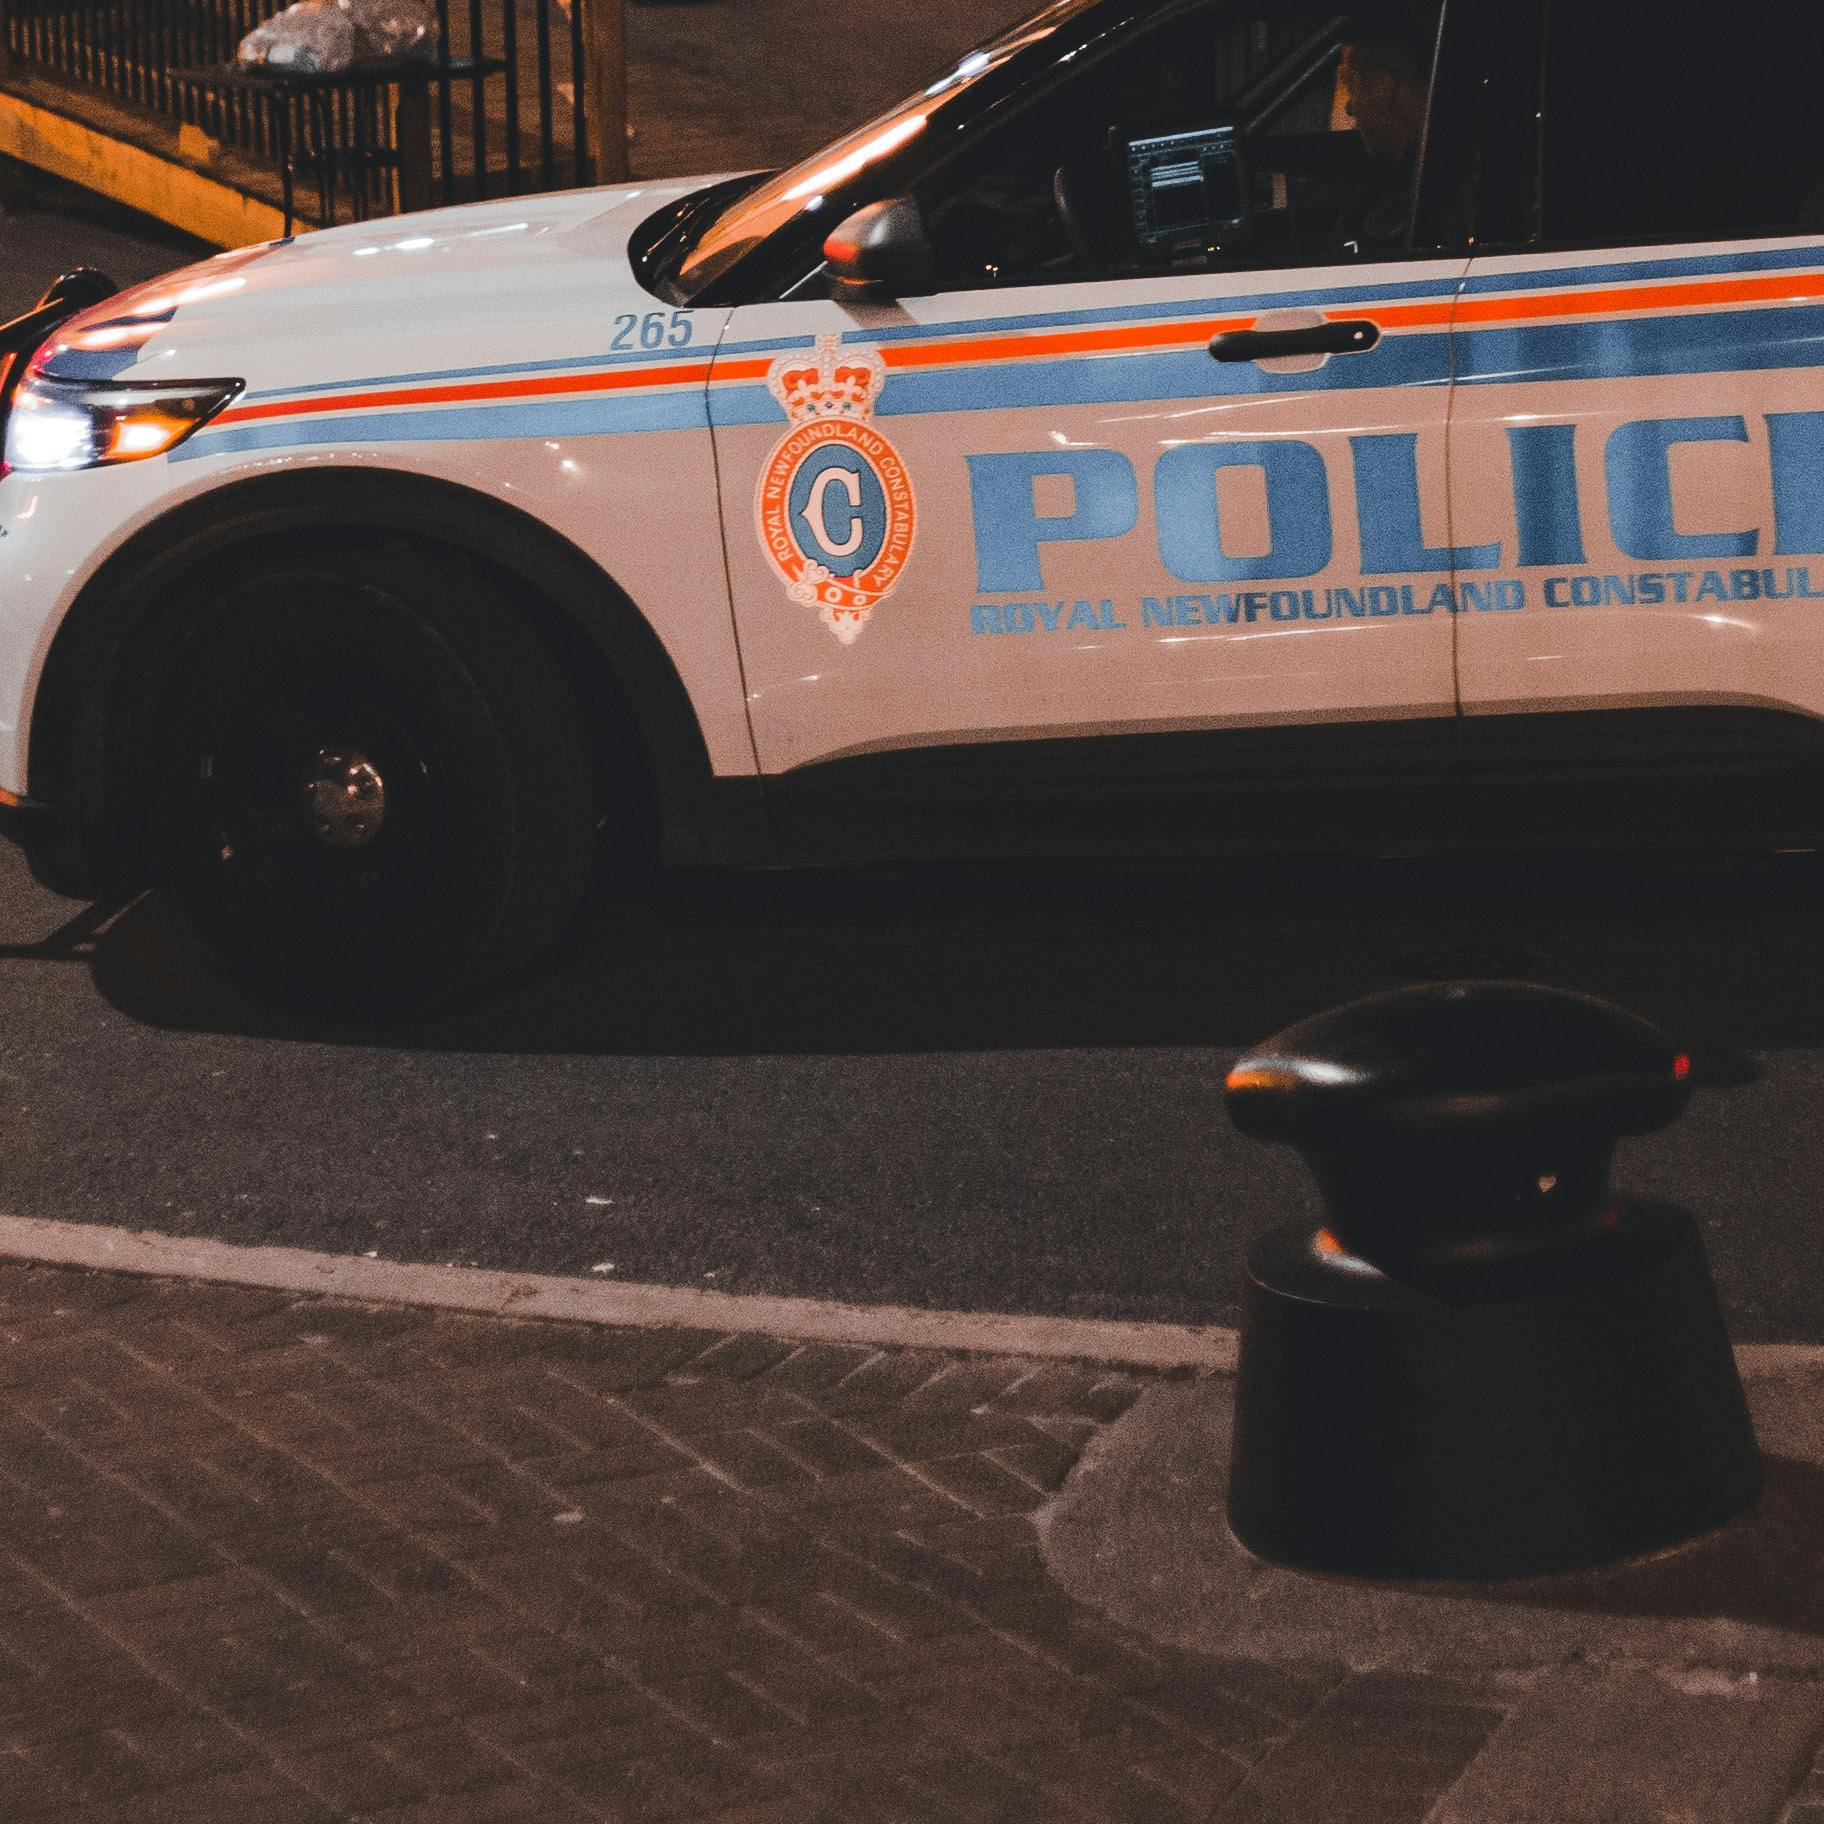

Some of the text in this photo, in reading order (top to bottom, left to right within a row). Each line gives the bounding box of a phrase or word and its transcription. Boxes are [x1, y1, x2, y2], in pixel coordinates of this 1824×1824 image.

[609, 310, 694, 352] 265
[766, 423, 911, 588] ROYAL NEWFOUNDLAND CONSTABULARY
[800, 466, 864, 557] C
[970, 598, 1126, 636] ROYAL
[1140, 578, 1525, 629] NEWFOUNDLAND
